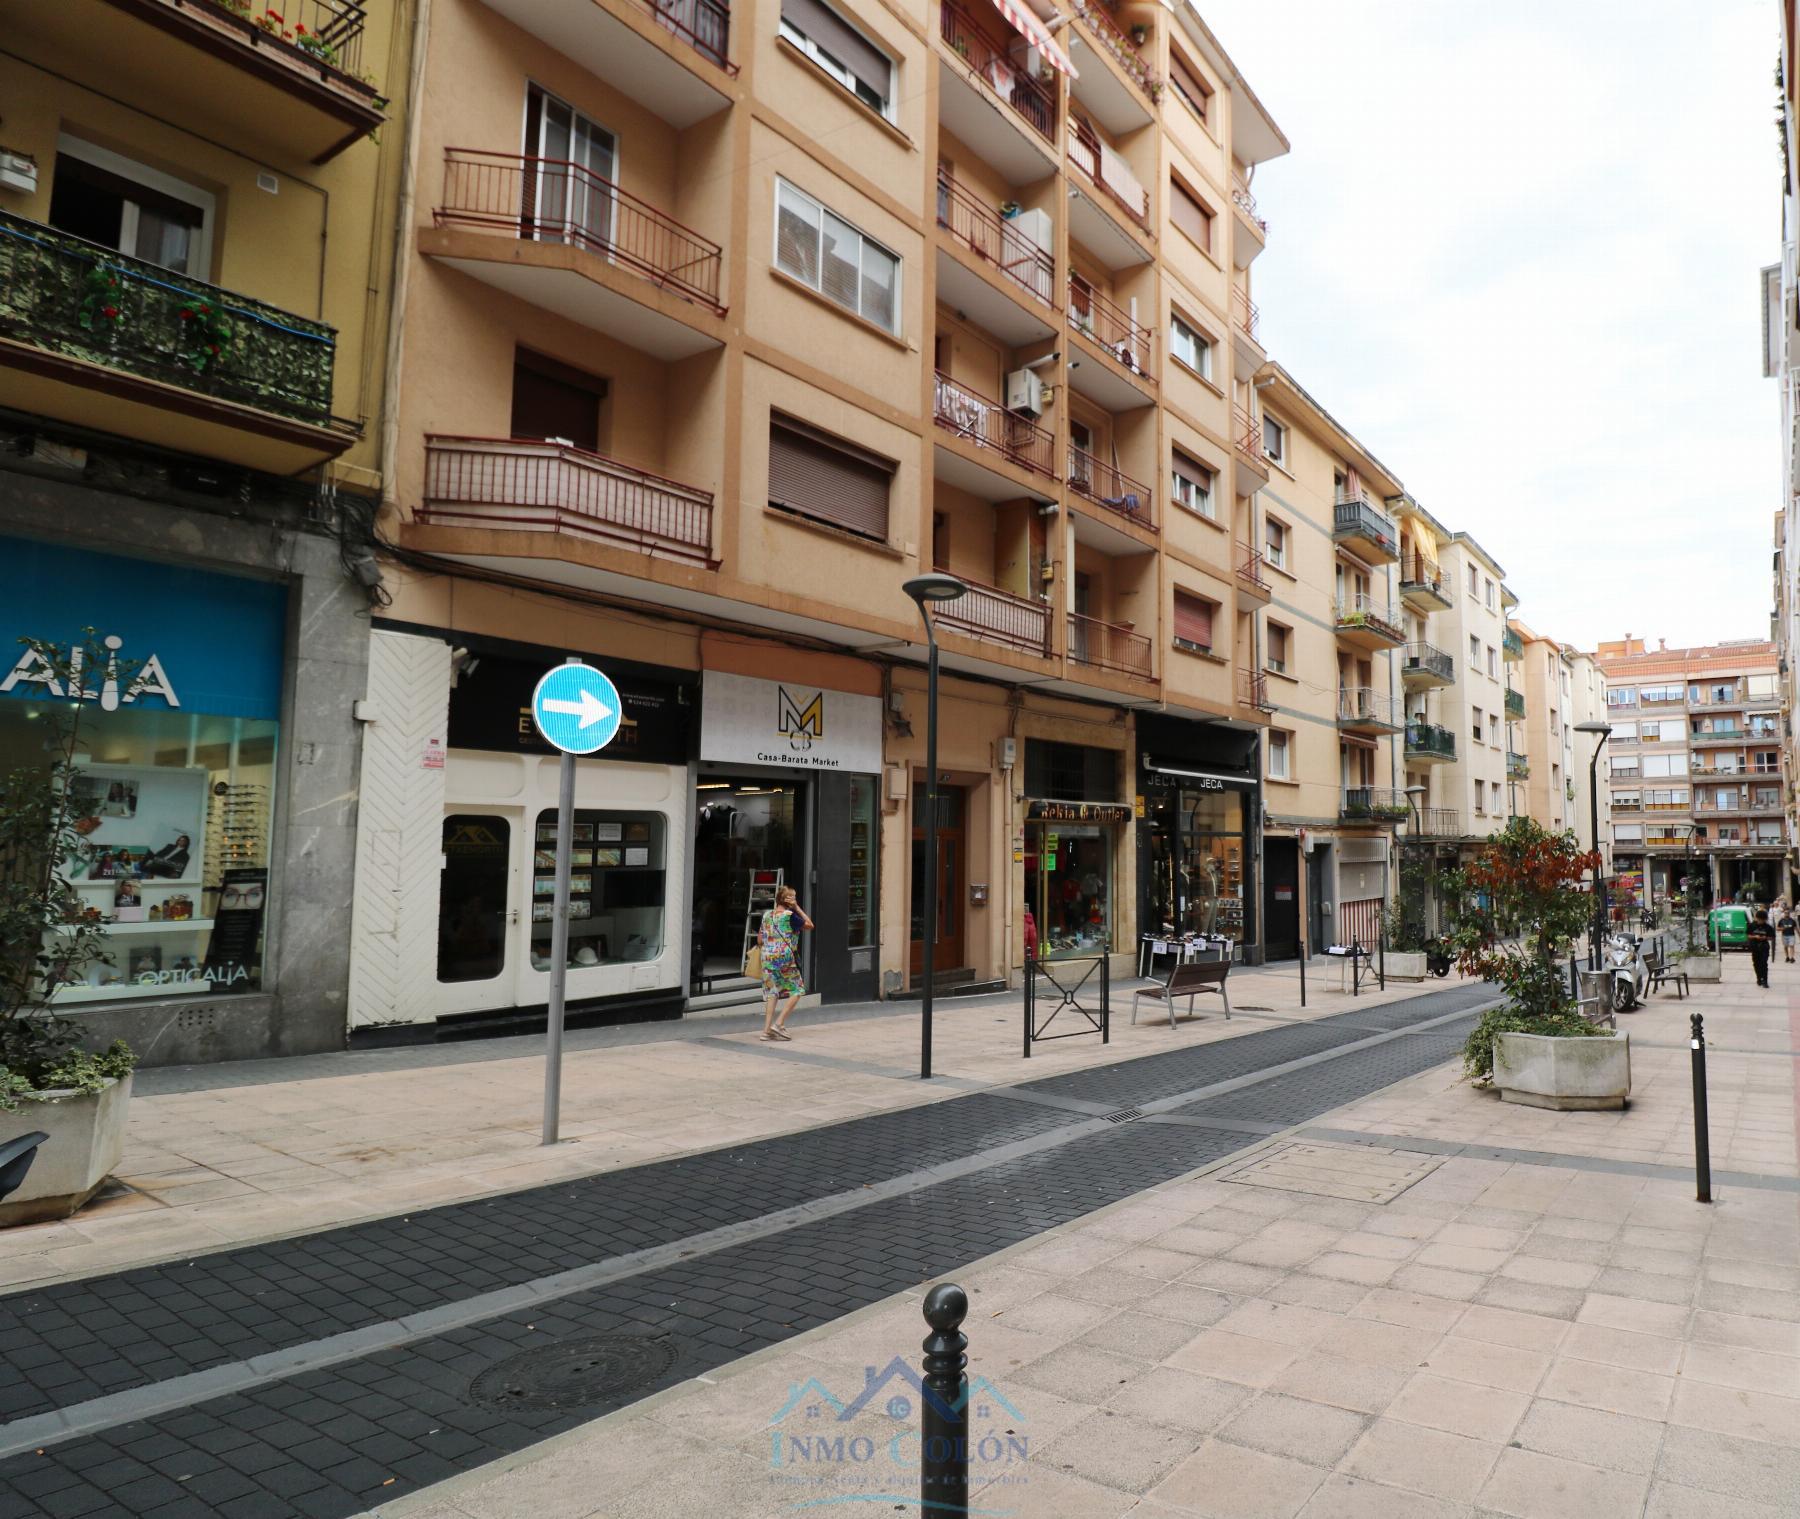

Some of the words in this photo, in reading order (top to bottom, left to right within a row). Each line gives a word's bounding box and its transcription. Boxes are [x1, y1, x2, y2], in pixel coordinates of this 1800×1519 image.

[757, 752, 808, 764] Casa-Barata
[812, 757, 839, 767] Market
[1147, 774, 1177, 788] JECA
[1200, 778, 1224, 790] JECA
[1093, 806, 1124, 821] Outlet
